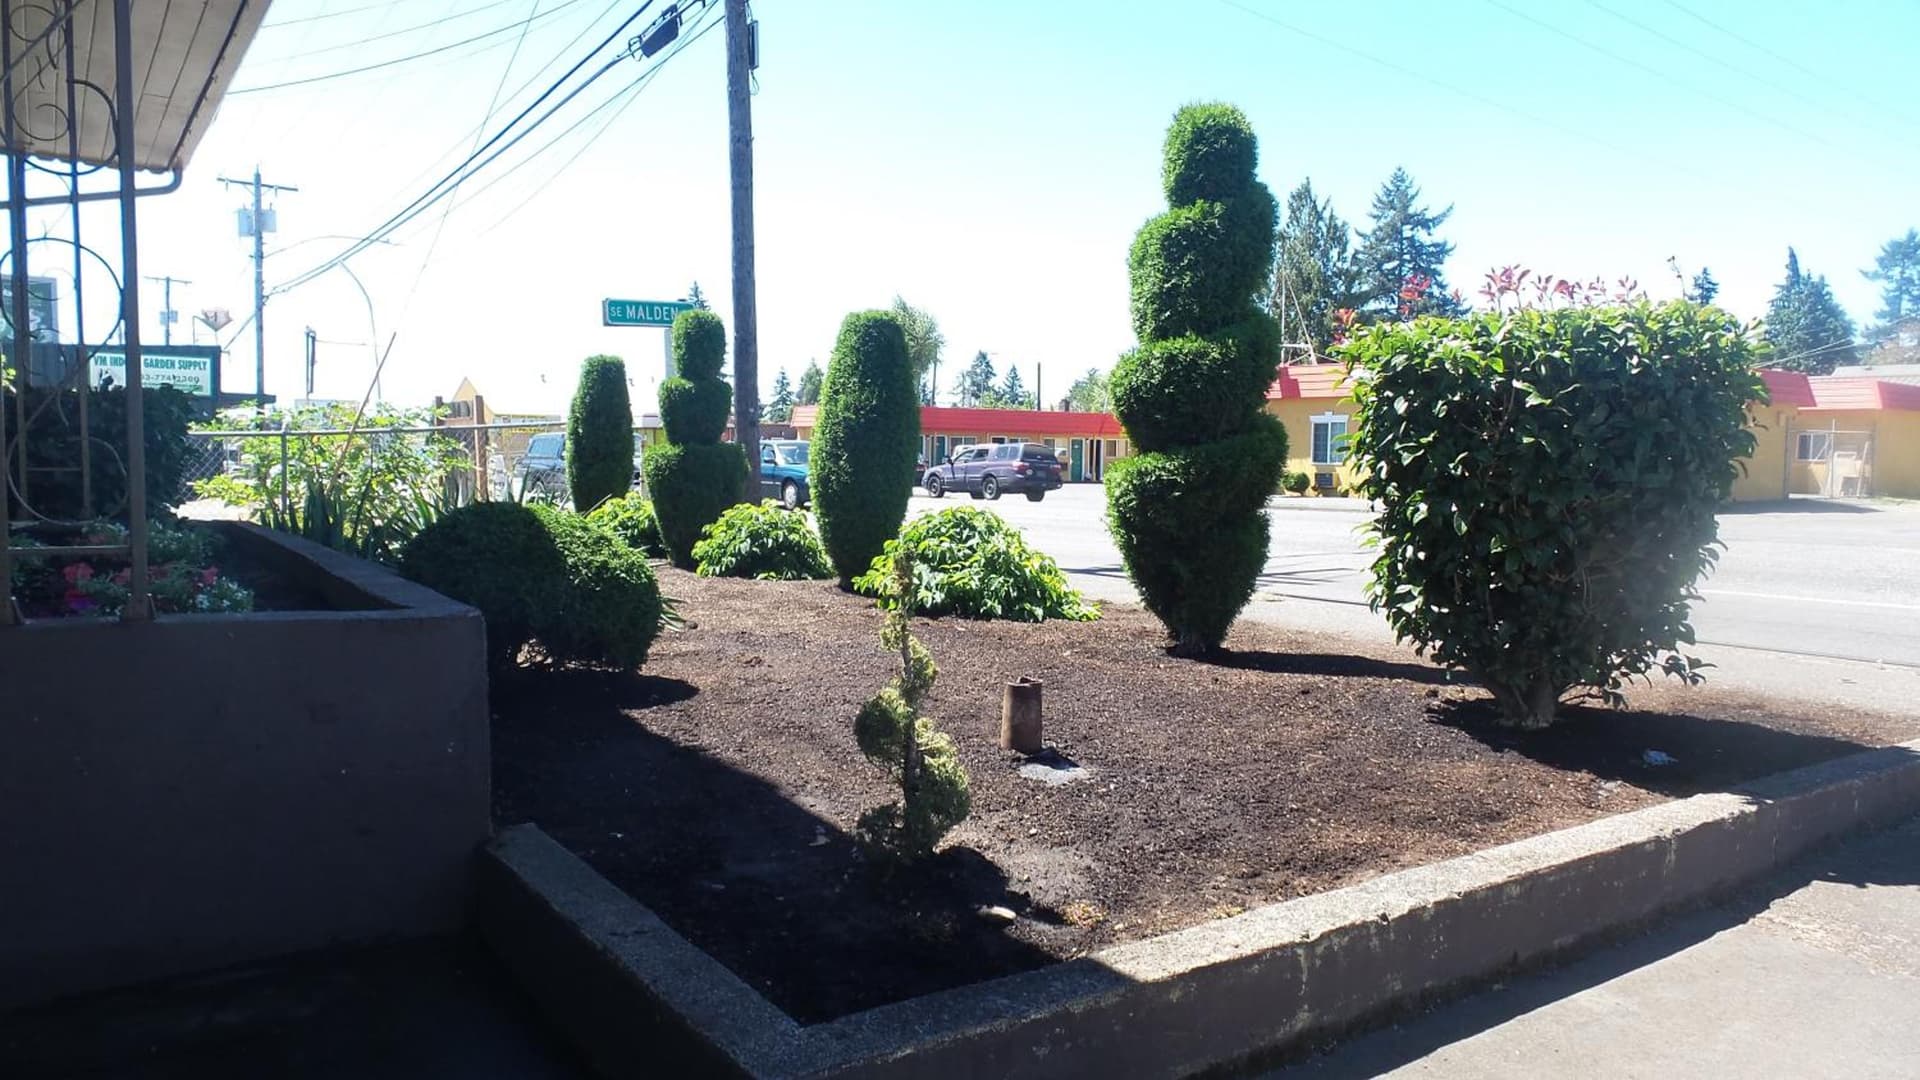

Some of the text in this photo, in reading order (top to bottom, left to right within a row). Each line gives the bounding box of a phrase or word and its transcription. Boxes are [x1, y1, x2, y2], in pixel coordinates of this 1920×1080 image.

[610, 304, 679, 321] SE MALDEN
[143, 358, 176, 370] GARDEN
[177, 359, 207, 371] SUPPLY
